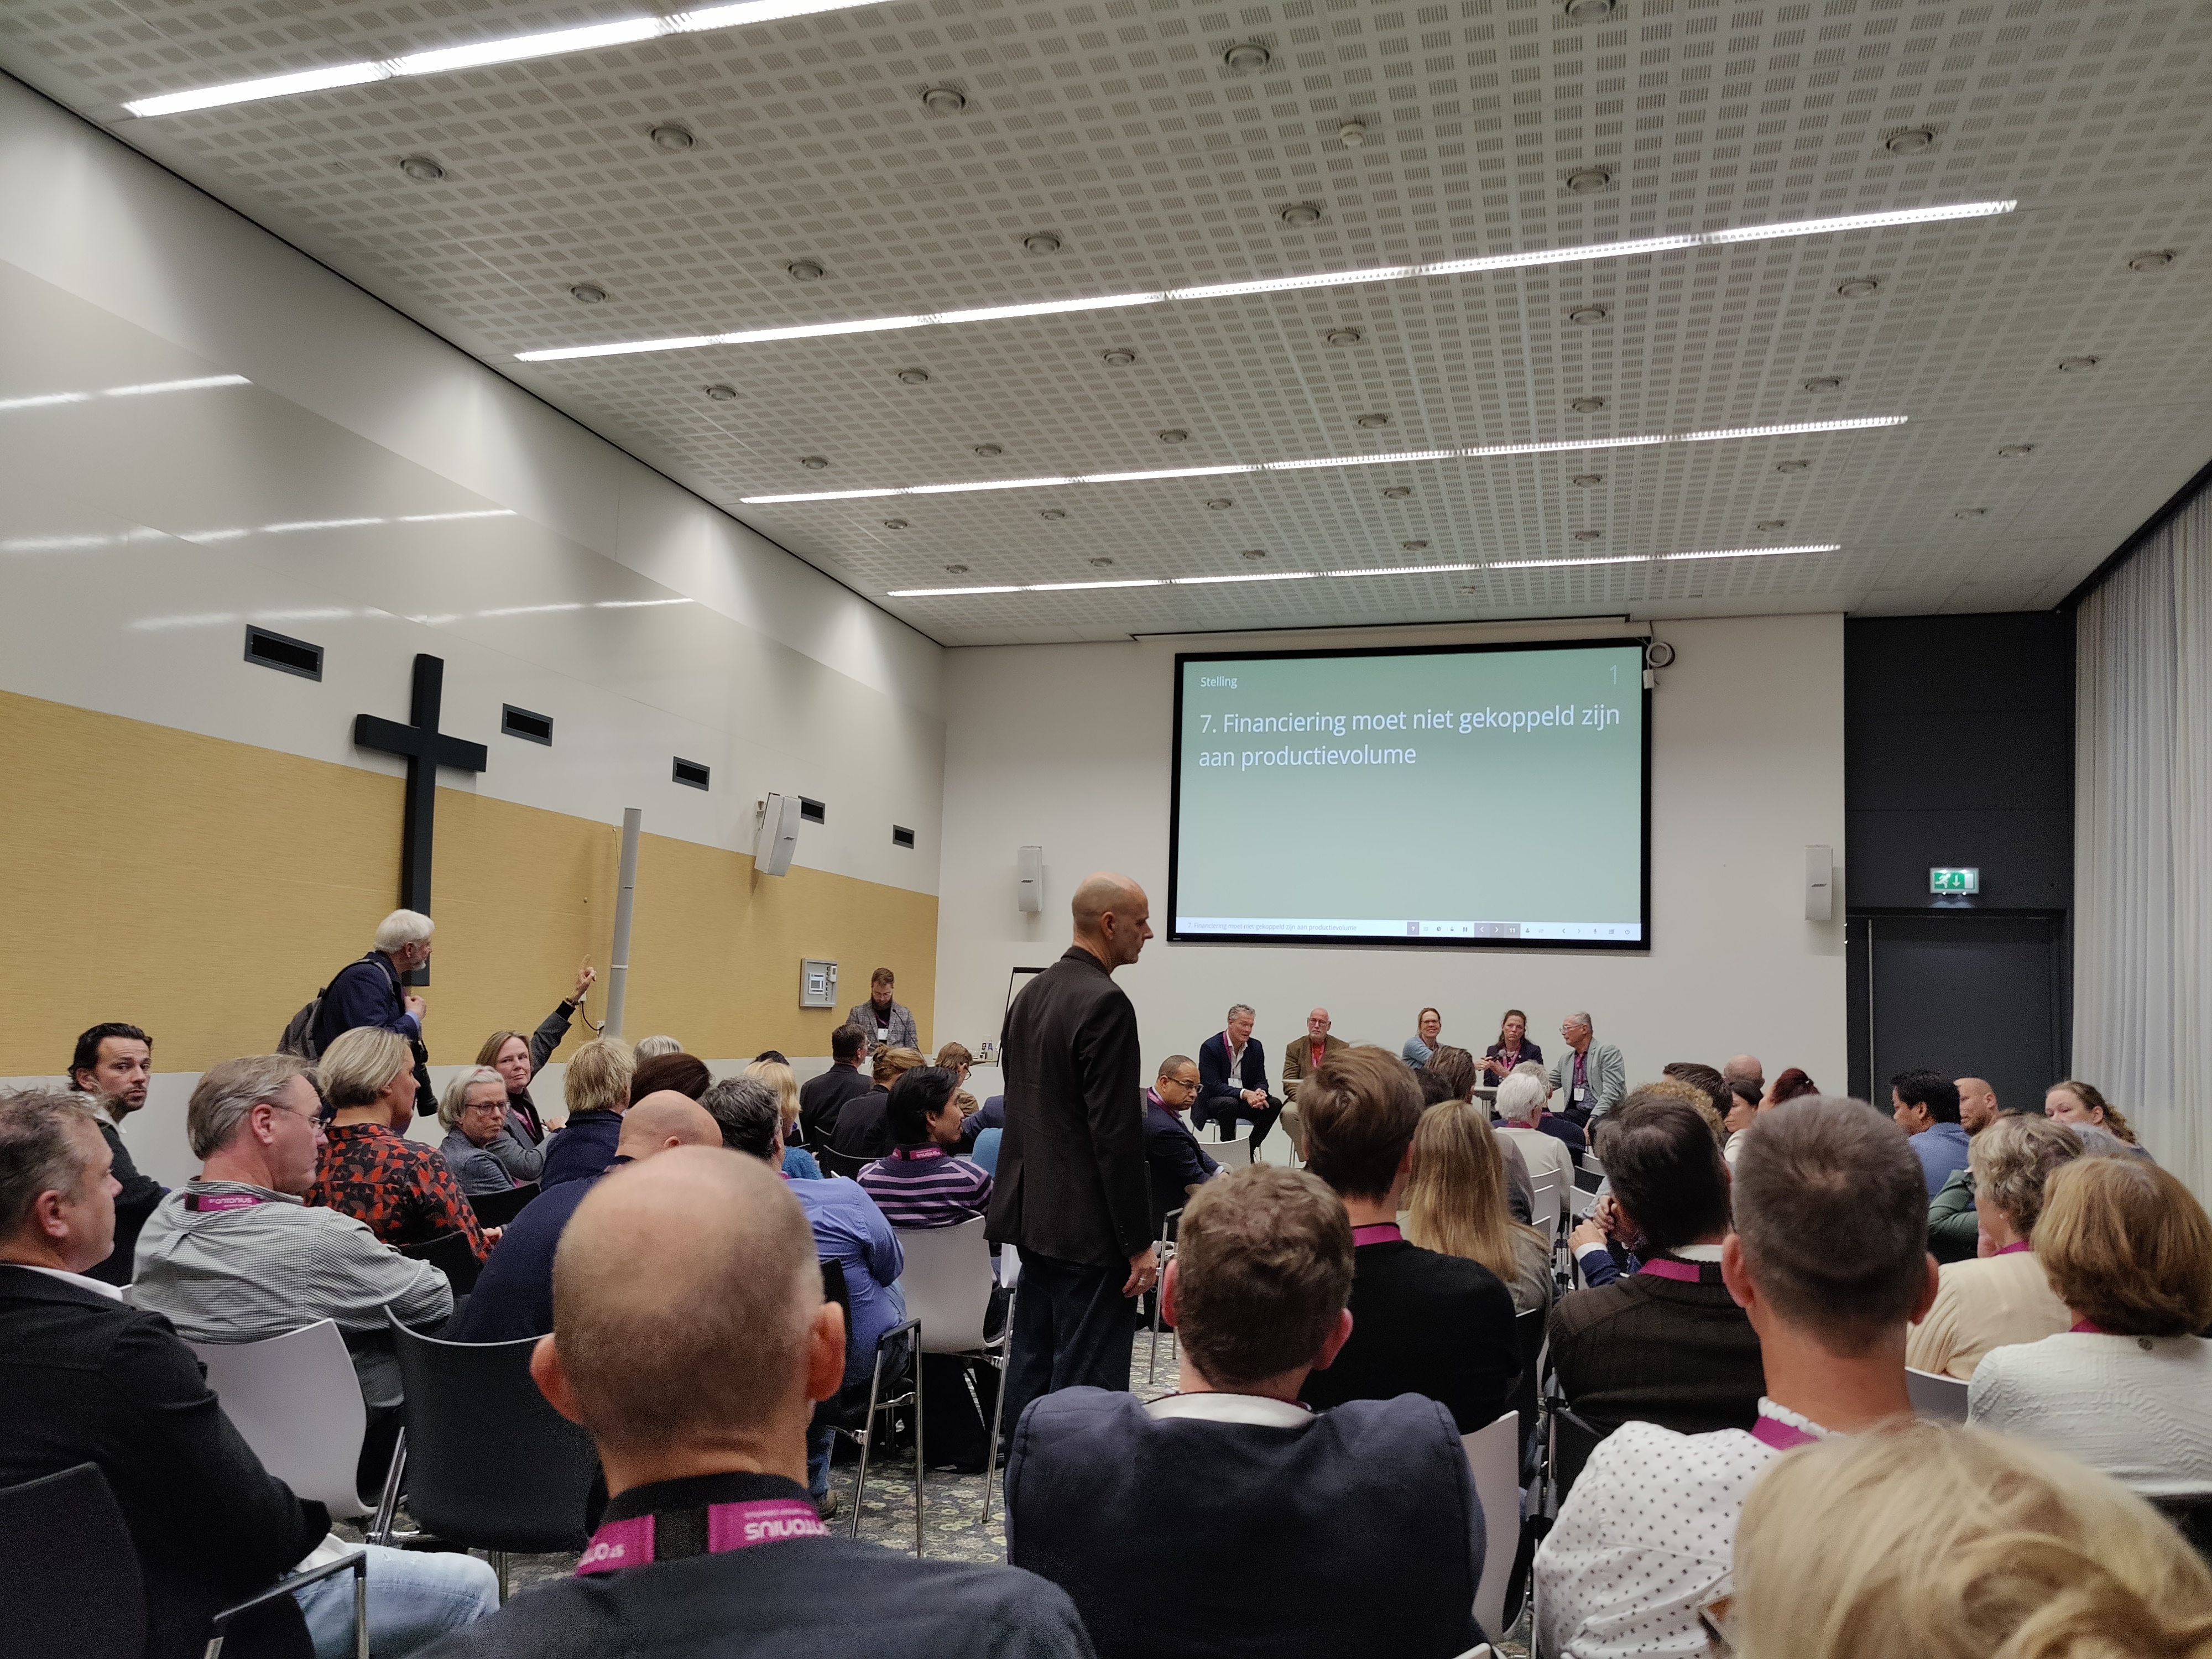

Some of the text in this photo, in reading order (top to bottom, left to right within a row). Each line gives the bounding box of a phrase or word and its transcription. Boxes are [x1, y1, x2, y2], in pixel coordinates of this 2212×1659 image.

[1200, 676, 1238, 689] Stelling
[1609, 665, 1618, 685] 1
[1200, 704, 1620, 737] 7. Financiering moet niet gekoppeld zijn
[1199, 744, 1417, 771] aan productievolume
